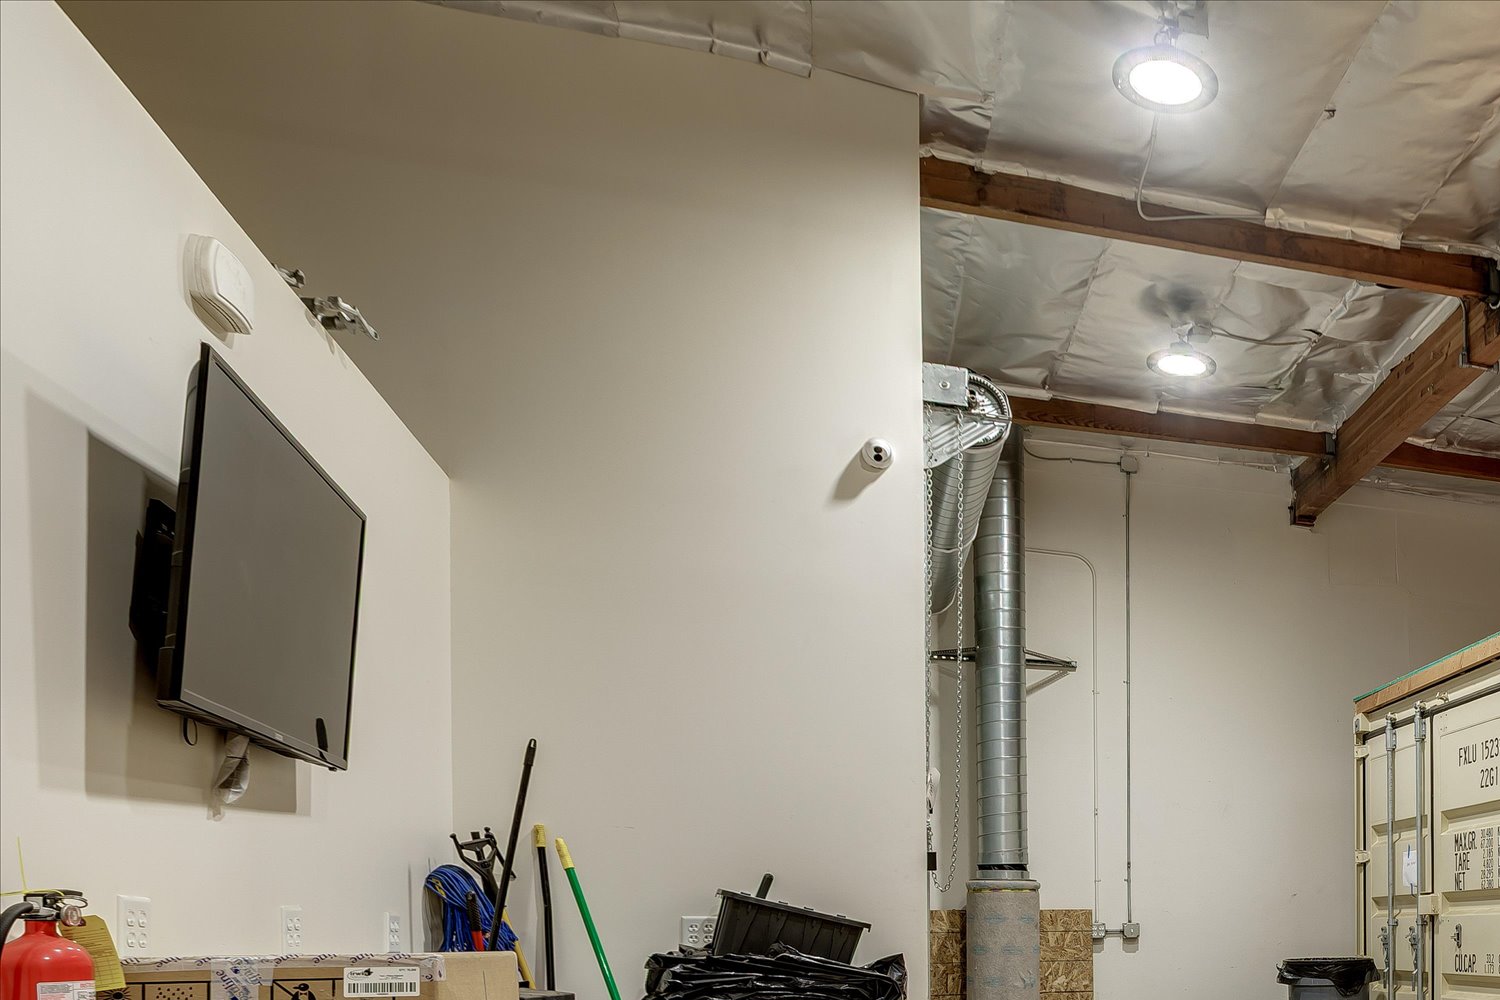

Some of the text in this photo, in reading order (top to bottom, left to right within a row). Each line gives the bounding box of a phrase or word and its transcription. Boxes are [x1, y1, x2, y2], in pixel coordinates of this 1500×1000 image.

[1458, 743, 1477, 767] FXLU
[1480, 766, 1498, 788] 22G1
[1454, 851, 1470, 871] TARE
[1454, 871, 1466, 891] NET
